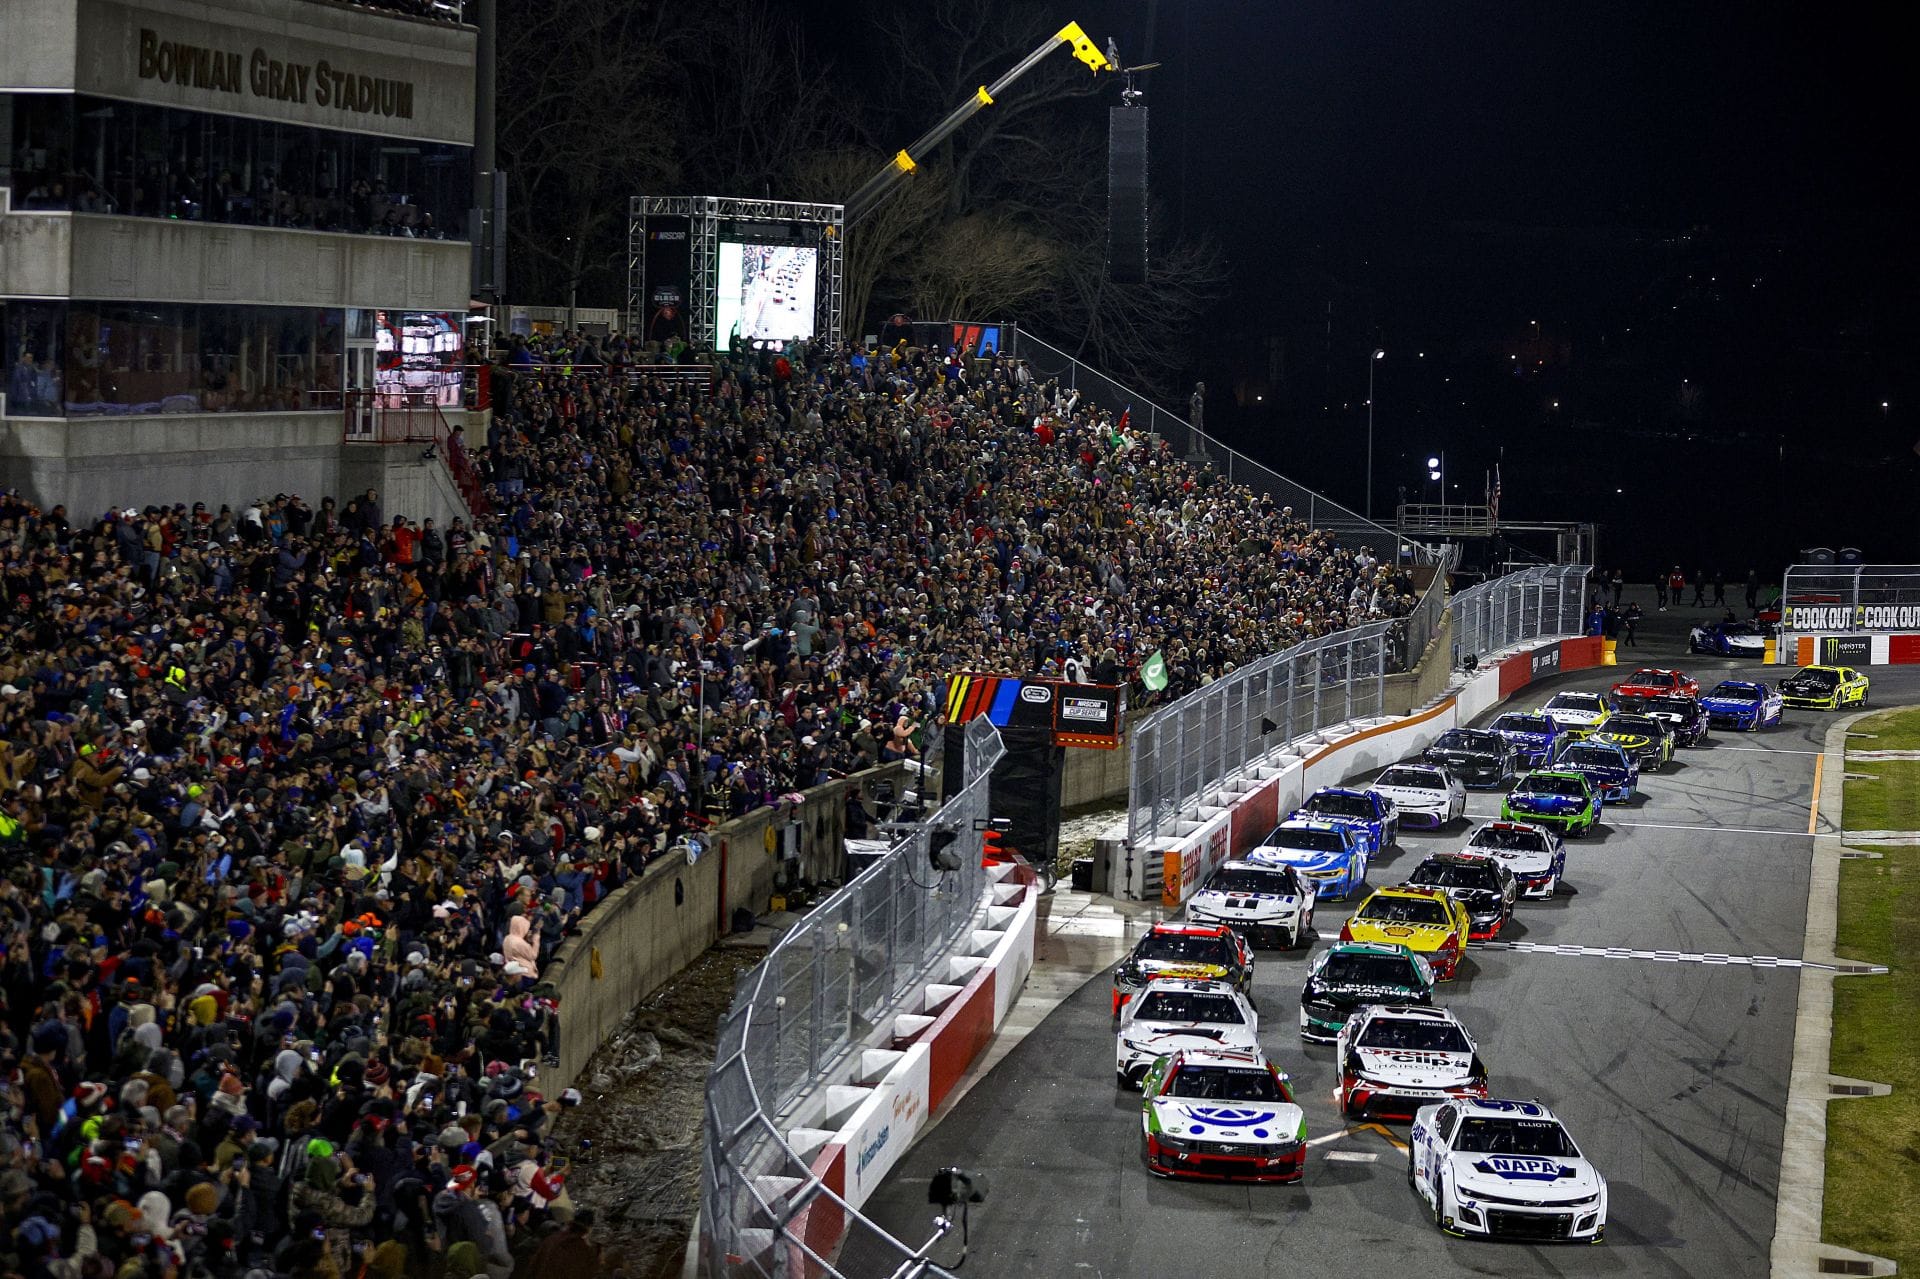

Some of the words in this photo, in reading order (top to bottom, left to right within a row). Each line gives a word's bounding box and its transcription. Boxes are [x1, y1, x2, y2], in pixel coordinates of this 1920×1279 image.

[250, 47, 311, 104] GRAY
[315, 60, 414, 120] STADIUM
[658, 232, 686, 240] NASCAR
[1793, 607, 1828, 629] COOK
[1828, 607, 1853, 629] OUT
[1864, 606, 1900, 628] COOK
[1078, 700, 1102, 708] NASCAR
[1081, 709, 1100, 717] SERIES
[1420, 1020, 1457, 1028] HAMLIN
[1494, 1158, 1558, 1174] NAPA
